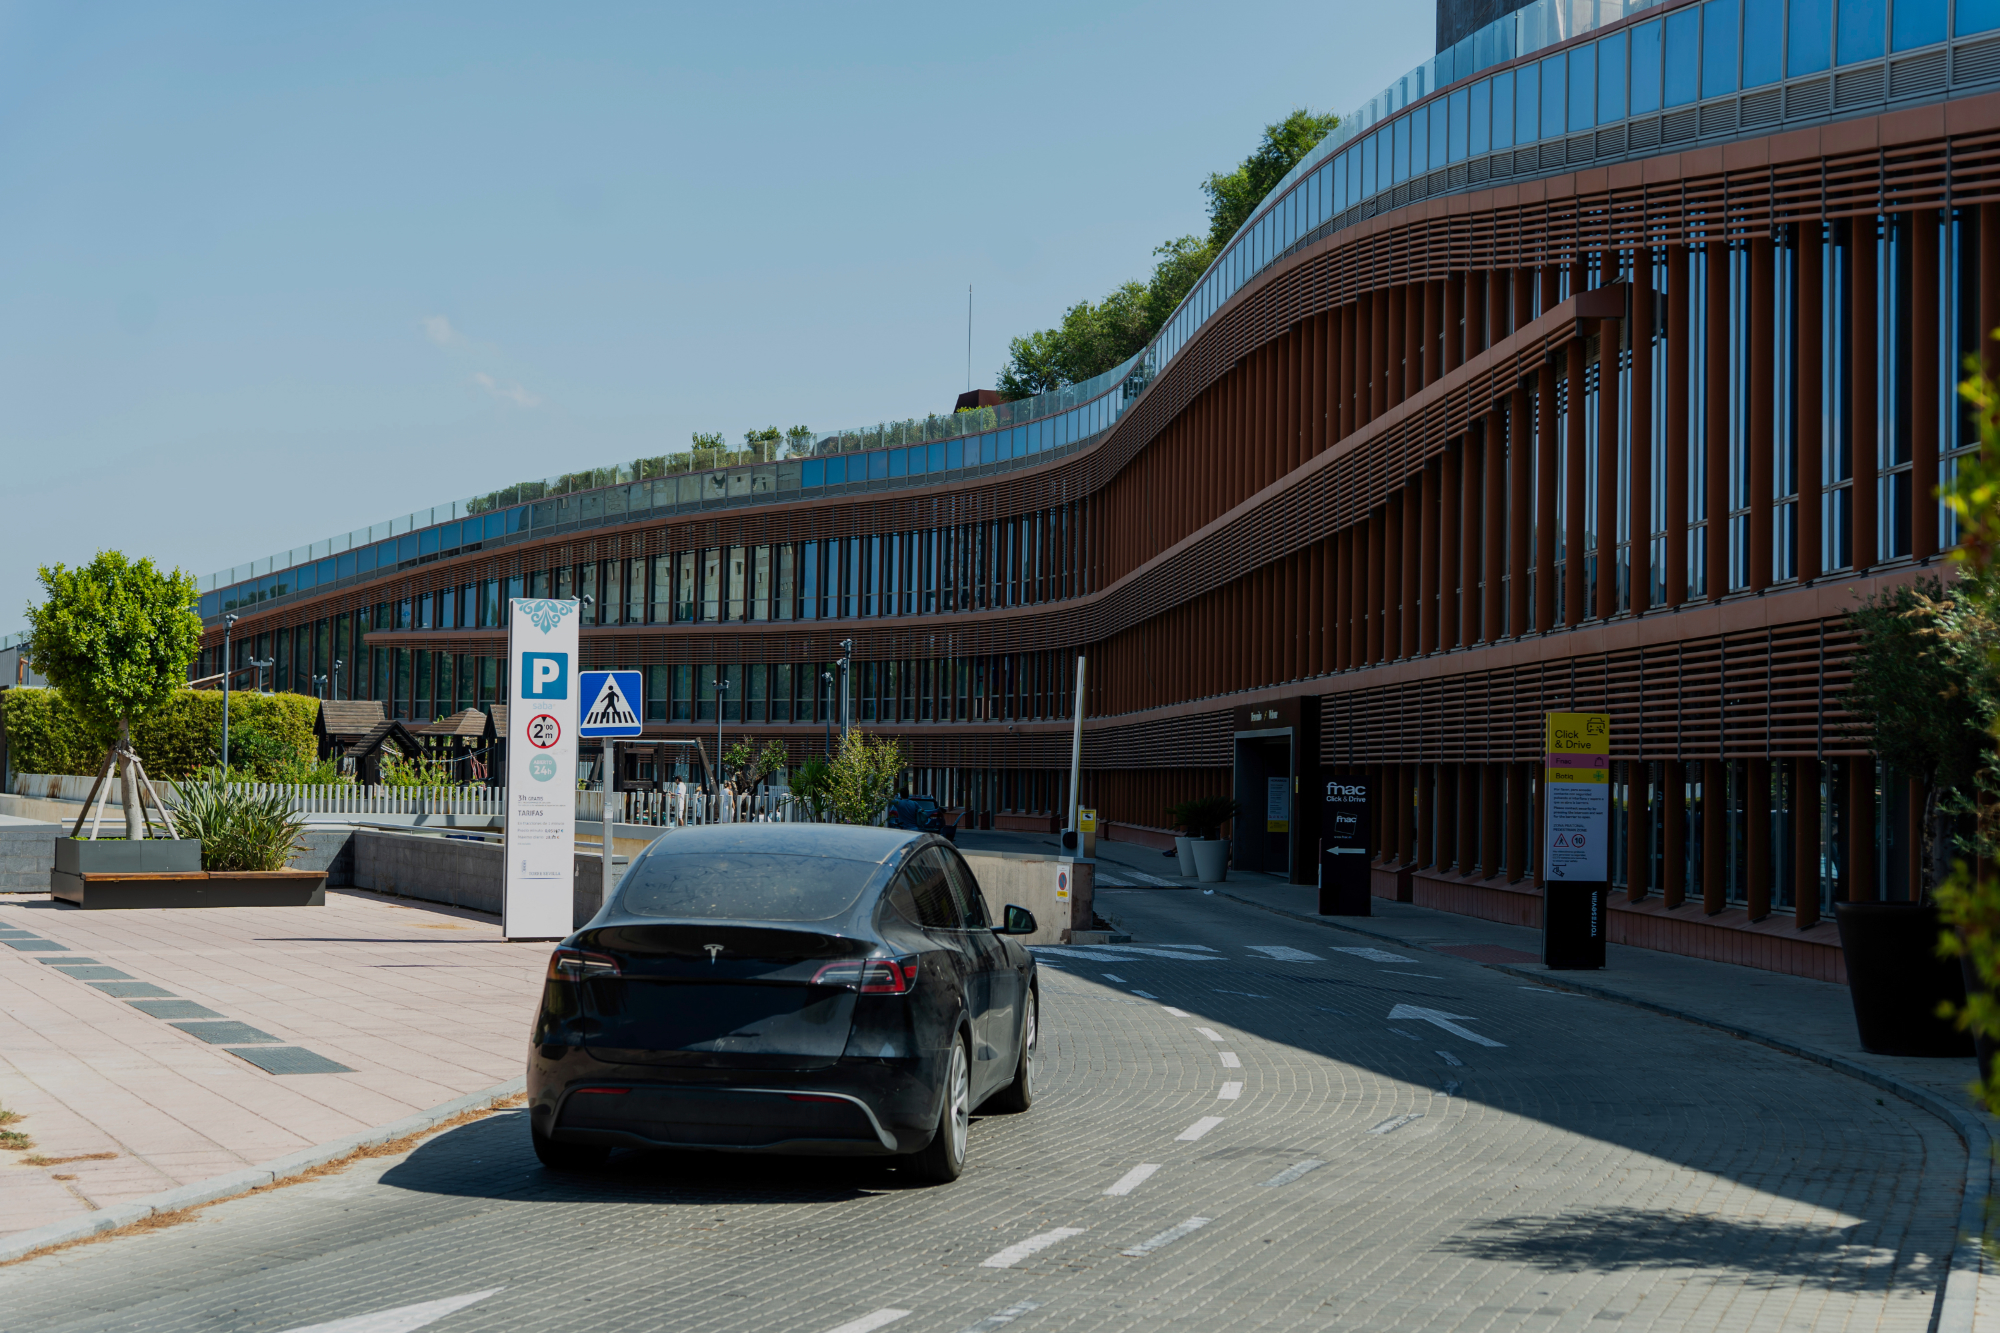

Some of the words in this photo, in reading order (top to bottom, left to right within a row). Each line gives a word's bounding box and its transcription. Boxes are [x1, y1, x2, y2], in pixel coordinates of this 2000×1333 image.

[533, 658, 560, 694] P
[1555, 730, 1578, 738] Click
[1555, 740, 1563, 748] &
[1566, 740, 1591, 749] Drive
[534, 766, 552, 775] 24h
[1326, 781, 1366, 795] fnac
